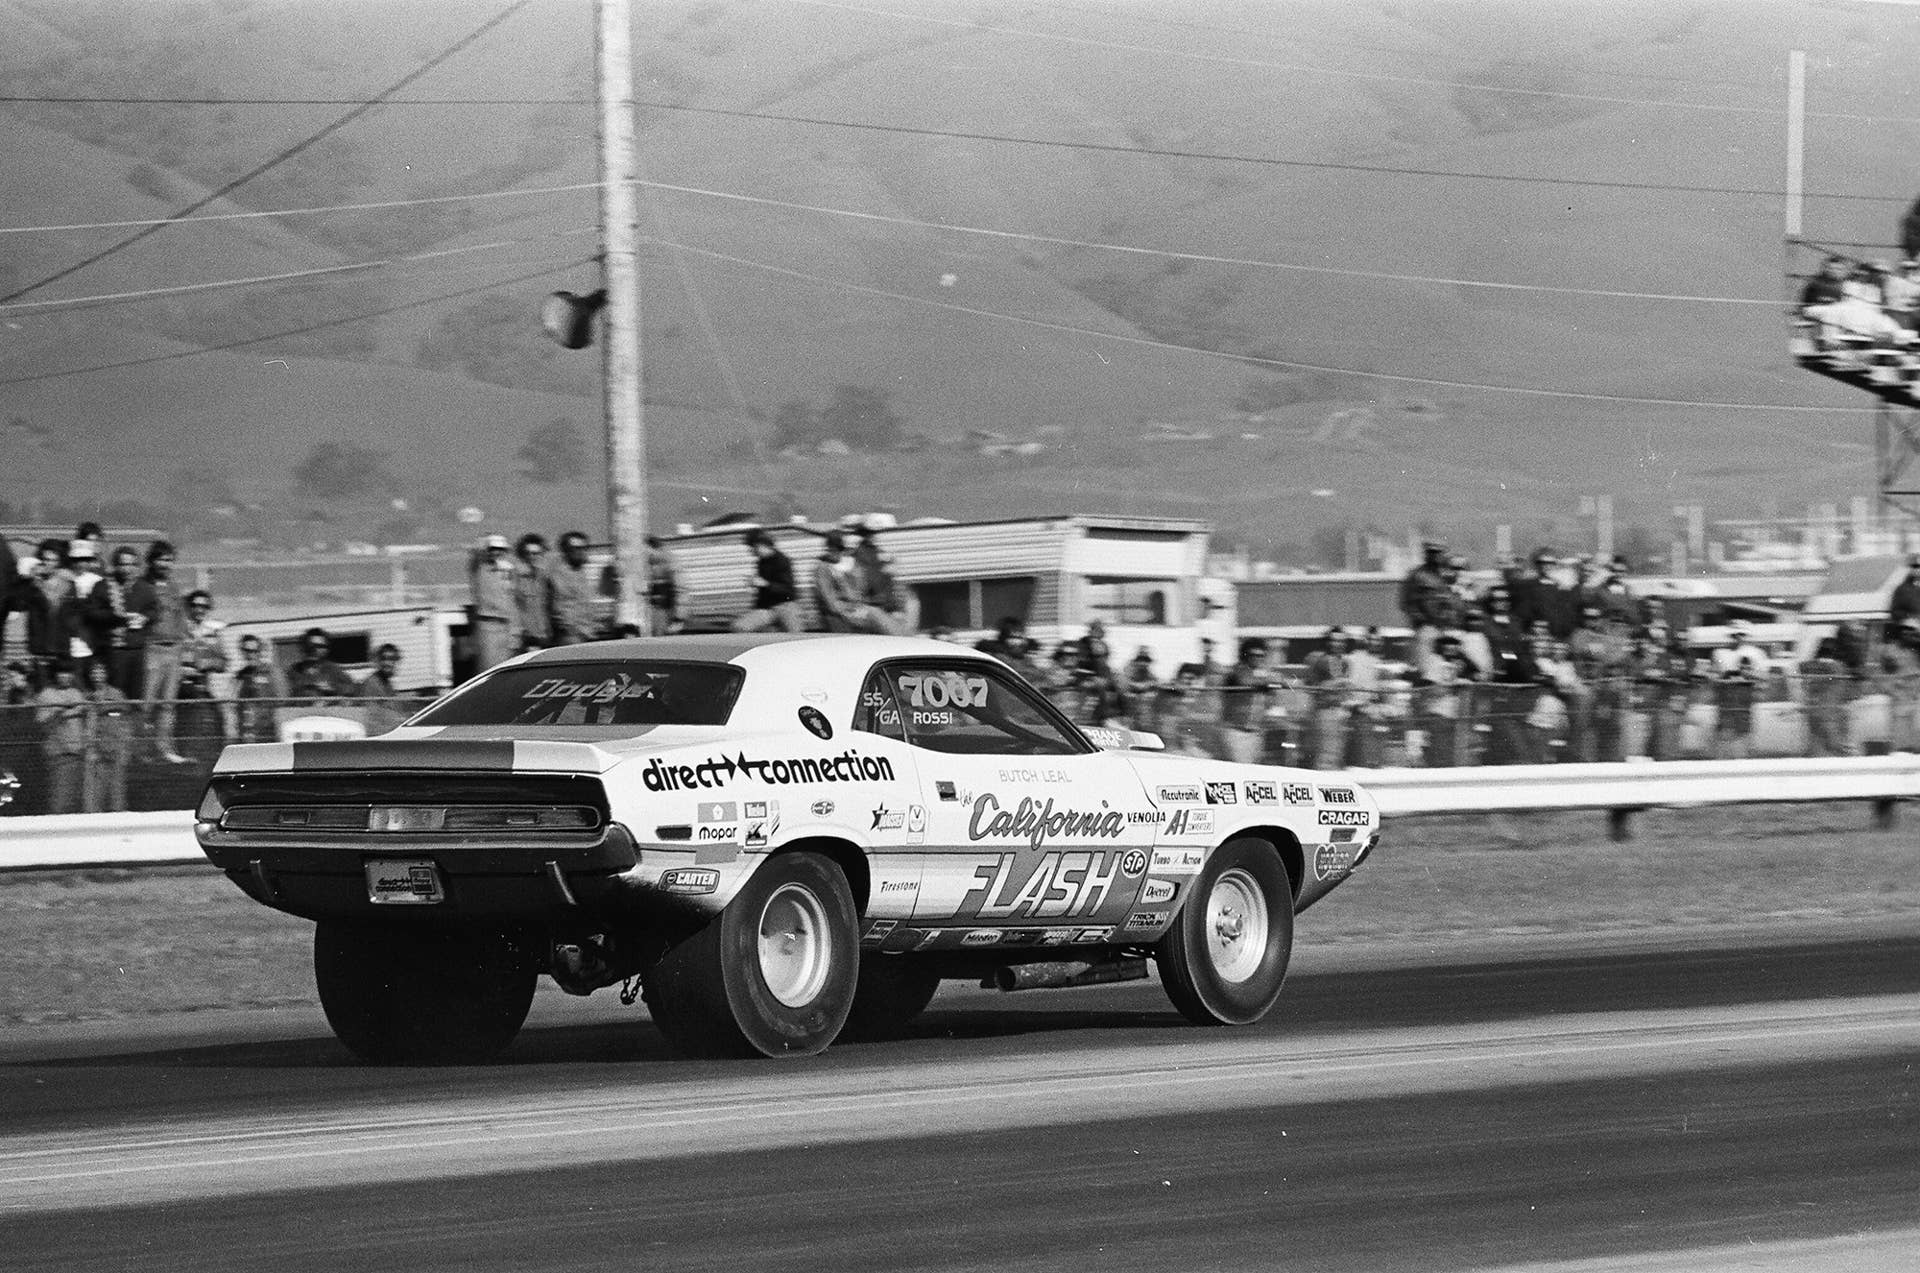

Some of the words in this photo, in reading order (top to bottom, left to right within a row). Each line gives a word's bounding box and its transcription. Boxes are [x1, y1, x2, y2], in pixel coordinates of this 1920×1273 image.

[913, 711, 953, 725] ROSSI
[642, 757, 727, 792] direct
[757, 749, 895, 785] connection
[998, 769, 1039, 783] BUTCH
[1041, 769, 1073, 783] LEAL
[969, 792, 1125, 851] California
[1127, 811, 1166, 823] VENOLIA
[1319, 810, 1369, 825] CRAGAR
[1124, 852, 1144, 872] STP
[675, 872, 717, 886] CARTER
[952, 851, 1124, 919] FLASH
